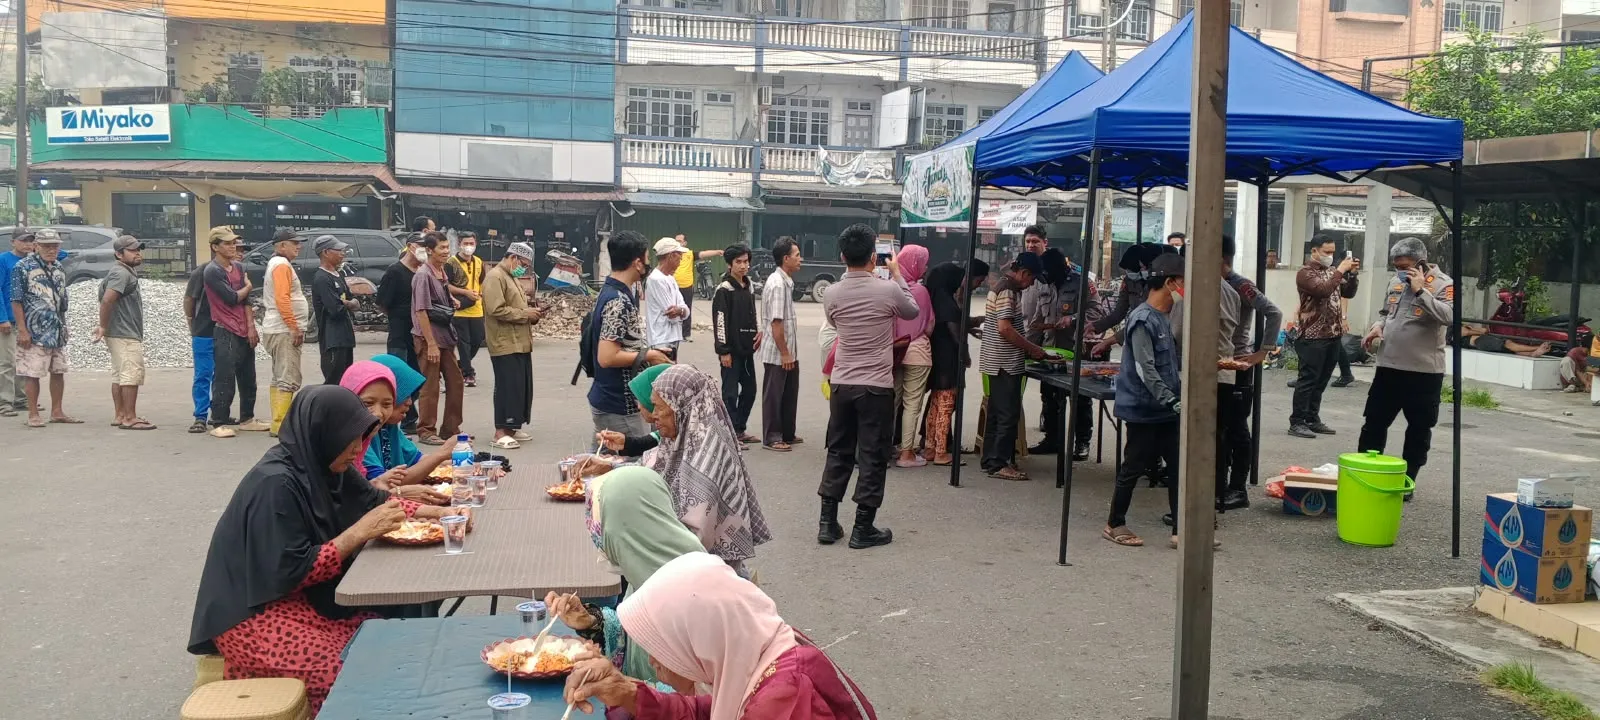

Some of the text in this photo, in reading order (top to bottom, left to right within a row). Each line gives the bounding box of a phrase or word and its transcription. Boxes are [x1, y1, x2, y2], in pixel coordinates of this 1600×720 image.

[80, 106, 154, 135] Miyako
[1502, 514, 1521, 535] AM
[1559, 518, 1576, 535] AM
[1498, 561, 1515, 579] AM
[1554, 566, 1571, 583] AM
